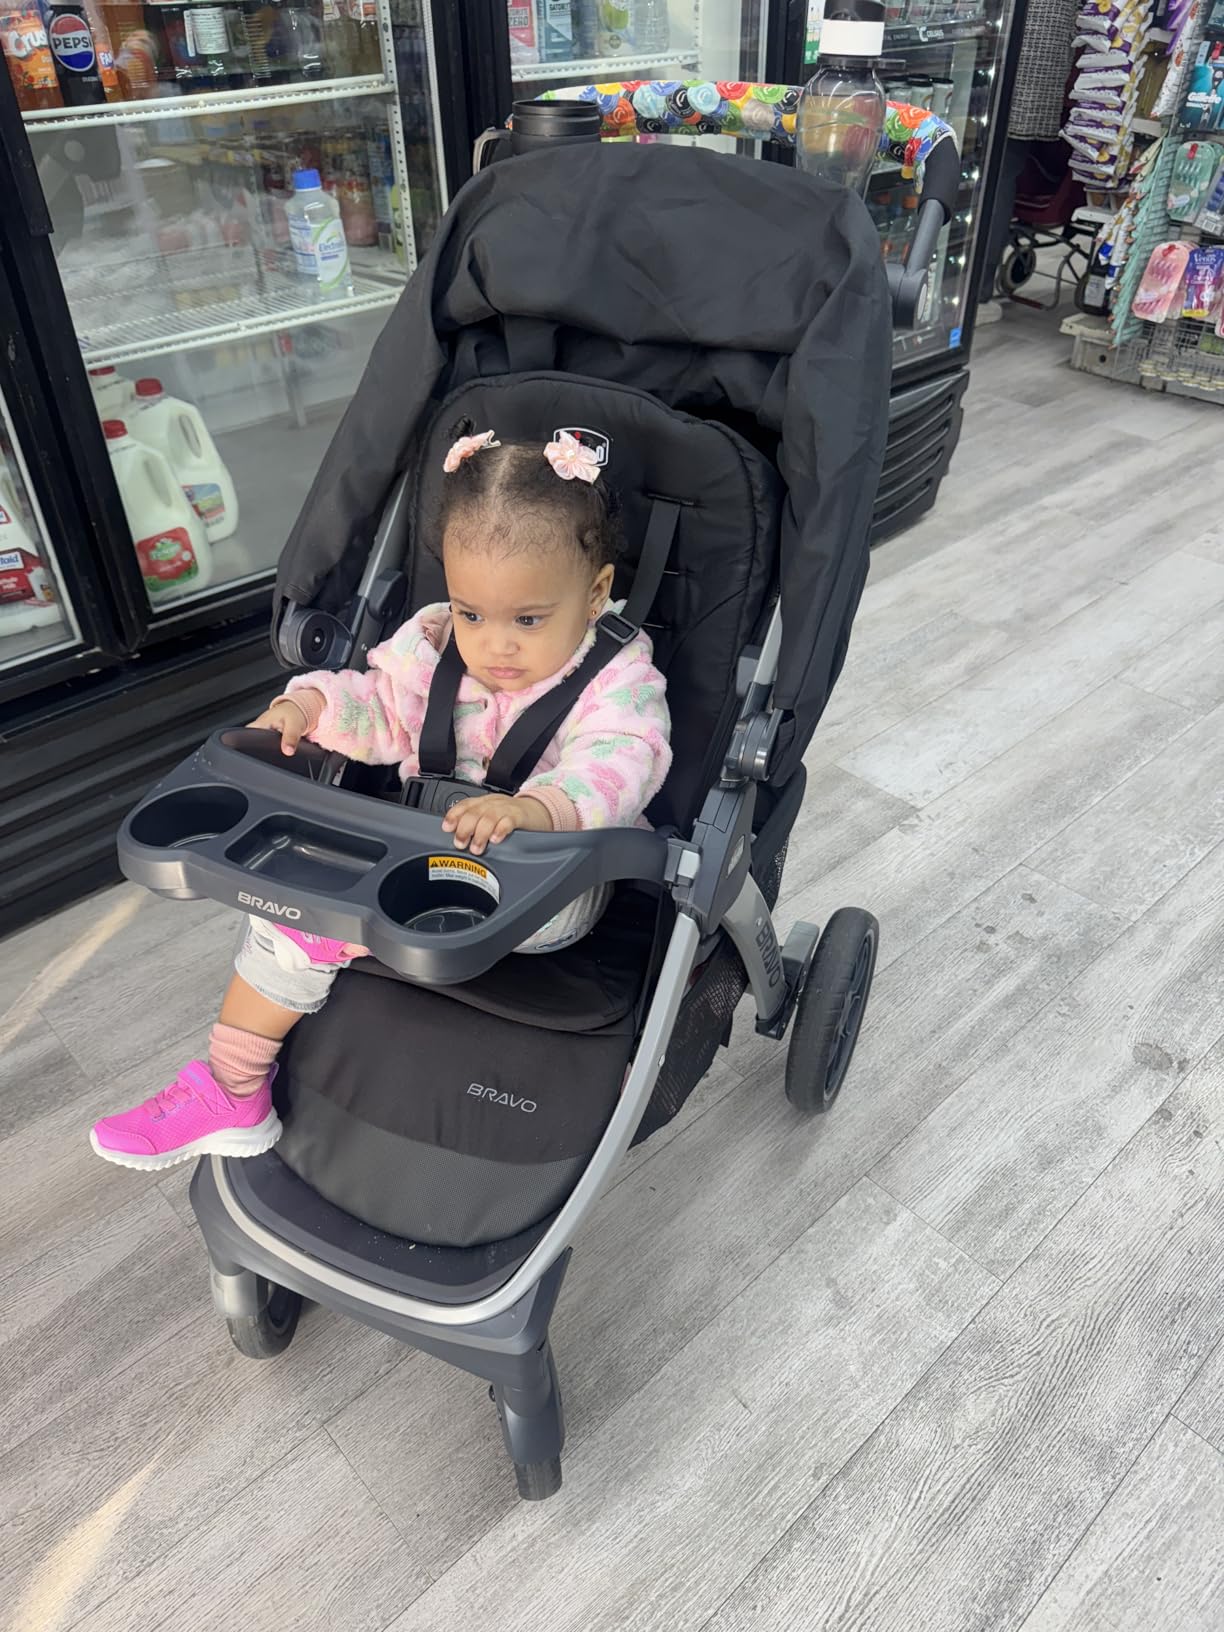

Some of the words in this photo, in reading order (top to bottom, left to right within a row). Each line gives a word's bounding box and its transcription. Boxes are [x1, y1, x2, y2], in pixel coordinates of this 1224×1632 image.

[8, 30, 49, 58] Crus
[52, 35, 93, 50] PEPSI
[1187, 91, 1222, 104] Gillette
[438, 859, 488, 879] WARNING
[237, 890, 302, 920] BRAVO
[756, 923, 781, 988] BRAVO
[466, 1082, 538, 1113] BRAVO
